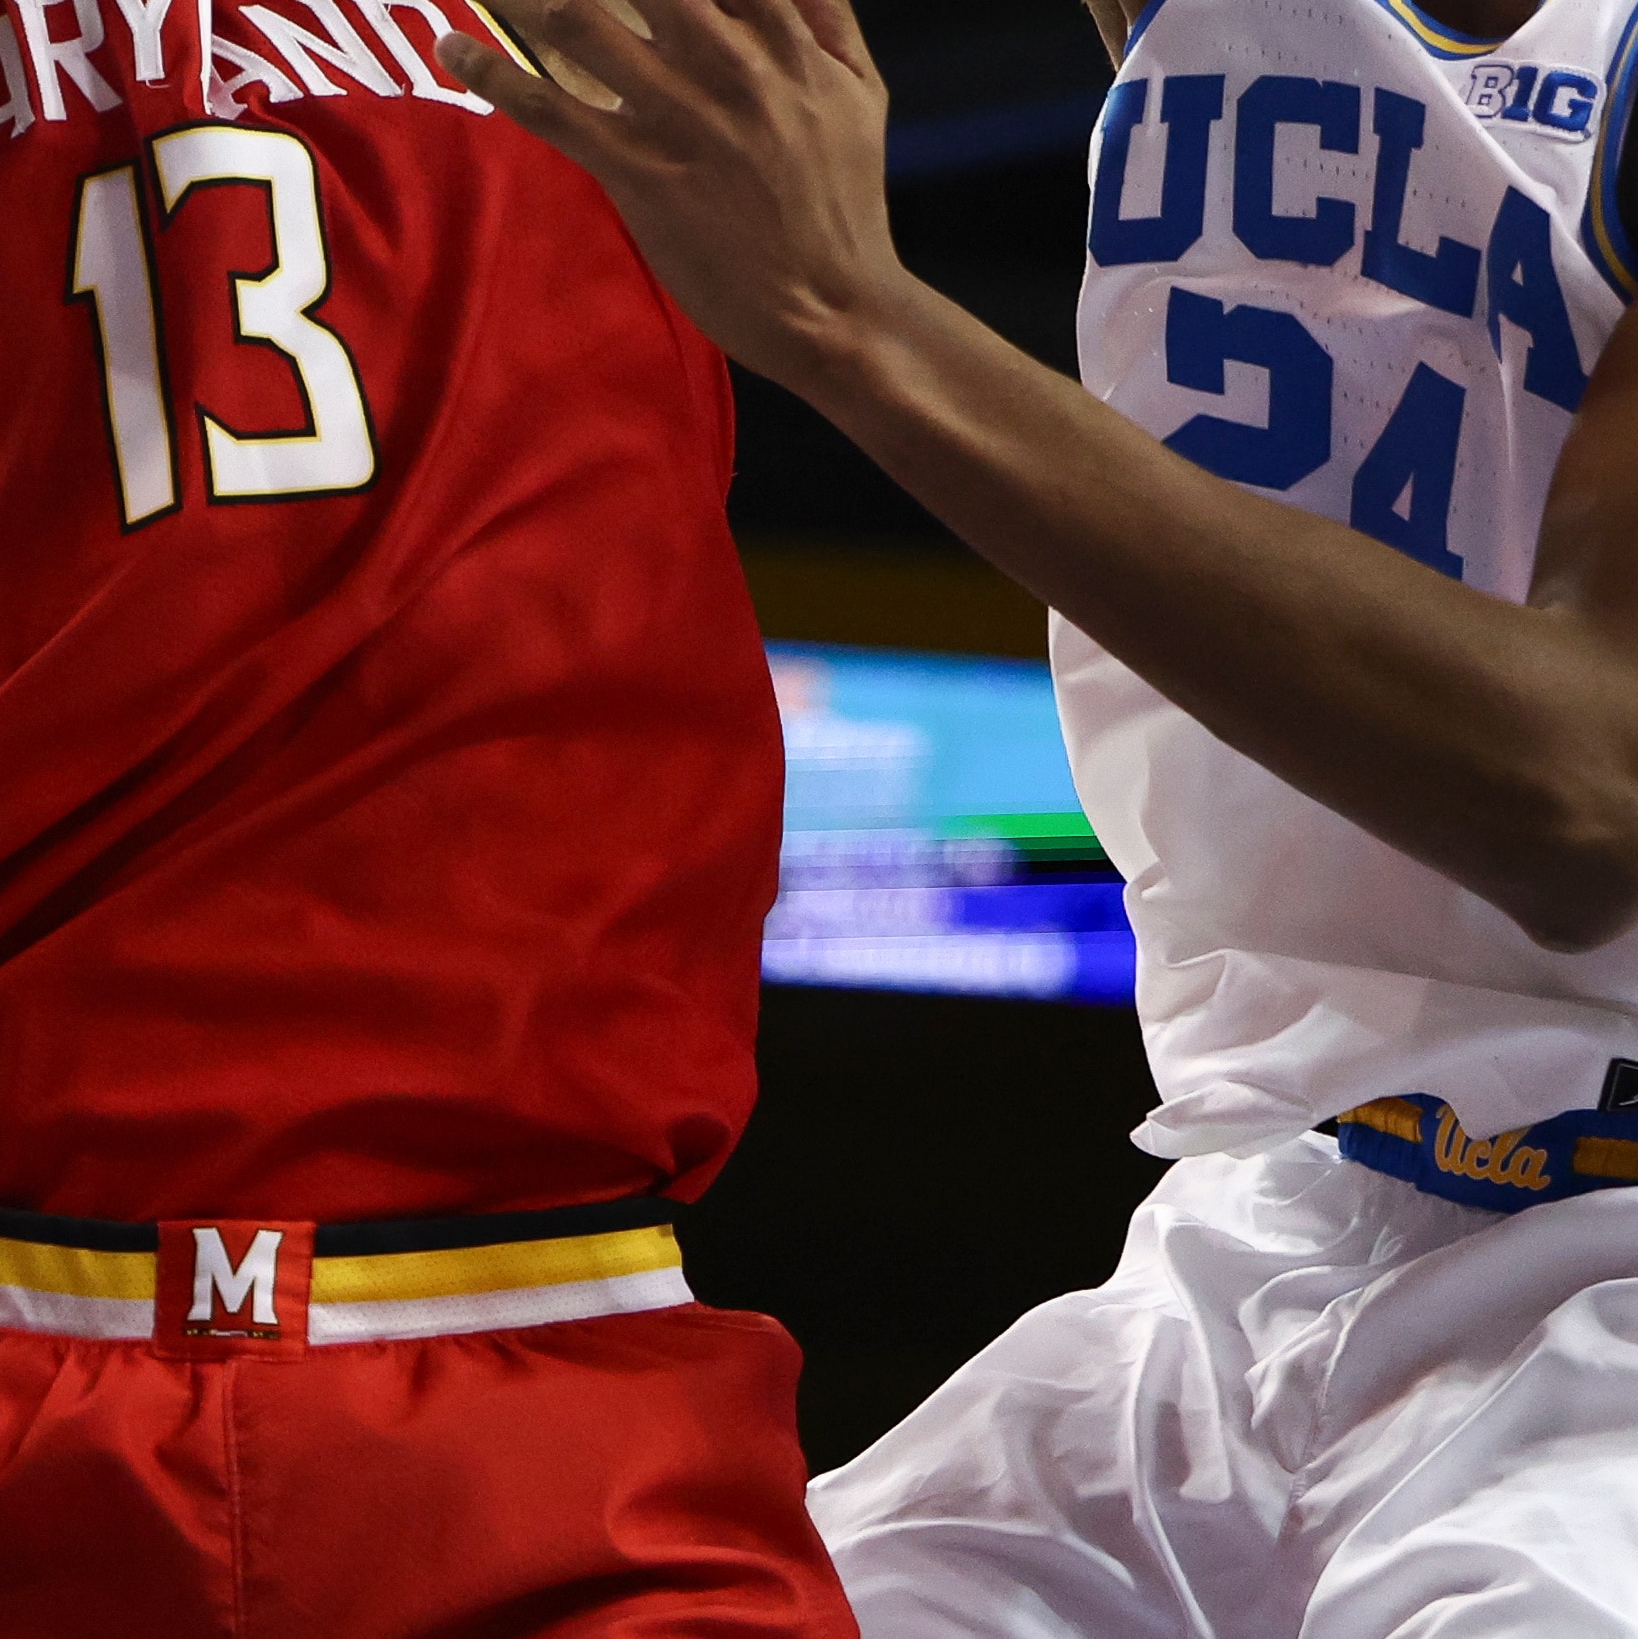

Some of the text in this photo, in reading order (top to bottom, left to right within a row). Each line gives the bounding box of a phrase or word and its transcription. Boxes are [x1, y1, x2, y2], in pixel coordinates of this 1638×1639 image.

[66, 124, 379, 532] 13
[1088, 73, 1590, 414] UCLA
[1161, 285, 1467, 583] 24
[186, 1227, 284, 1325] M
[1434, 1103, 1551, 1191] Ucla
